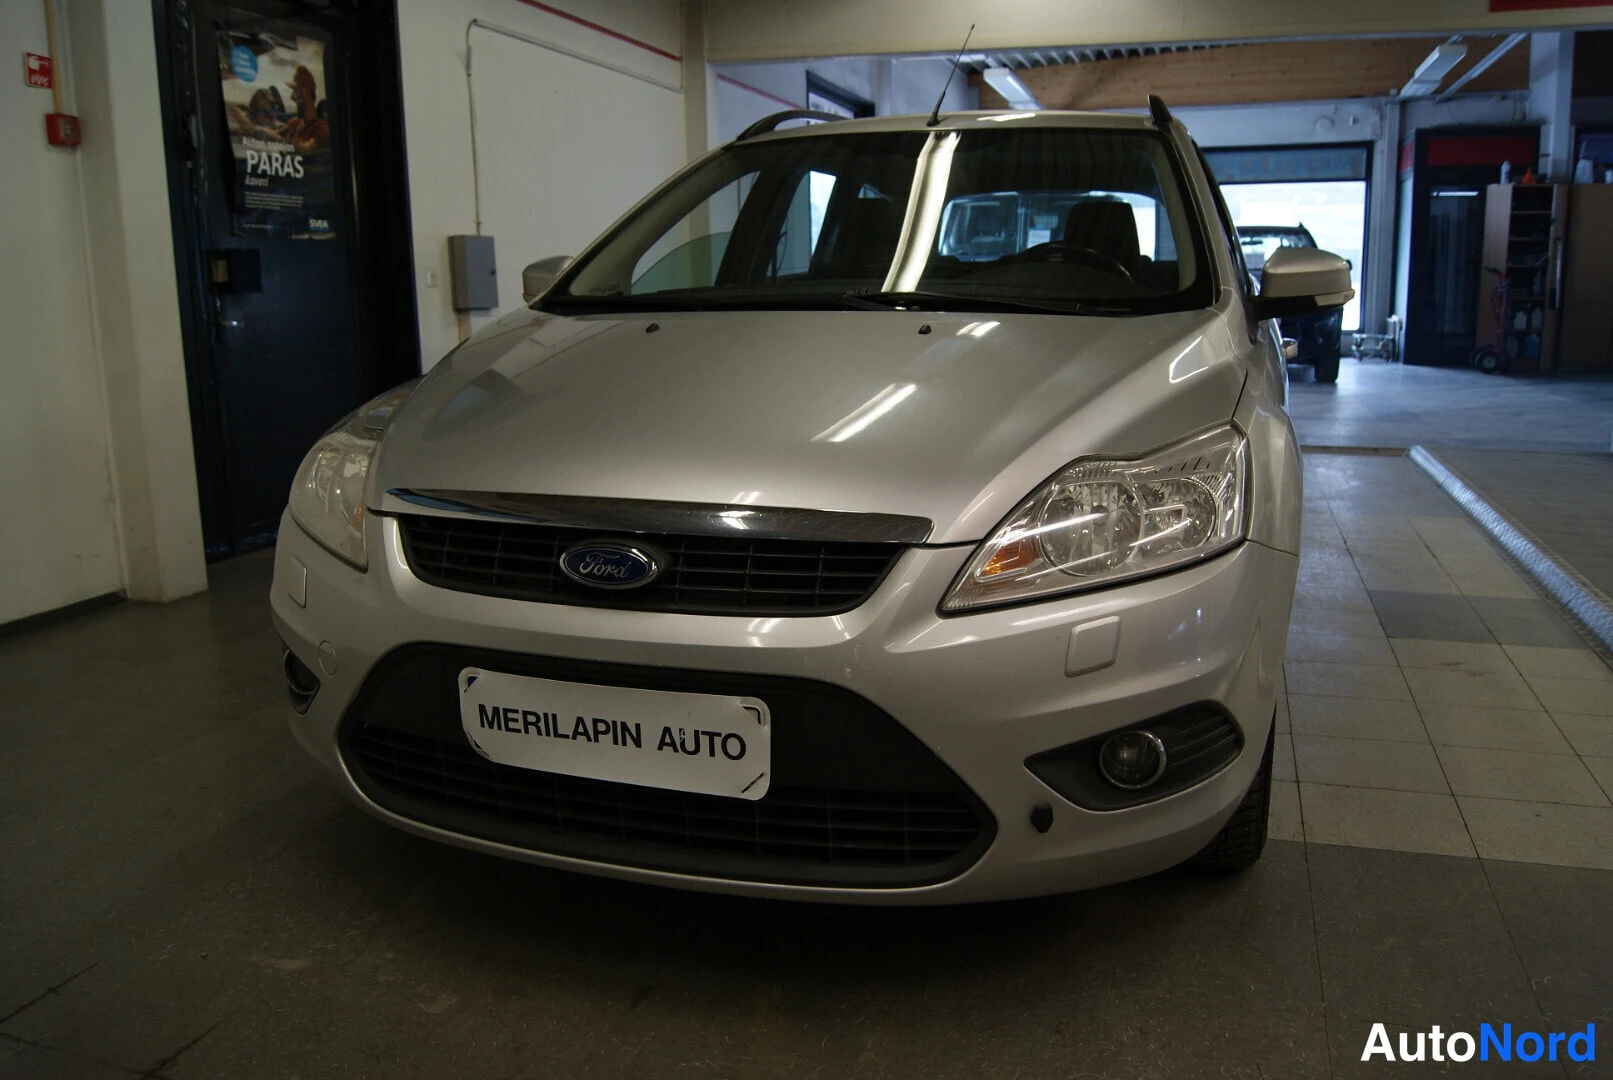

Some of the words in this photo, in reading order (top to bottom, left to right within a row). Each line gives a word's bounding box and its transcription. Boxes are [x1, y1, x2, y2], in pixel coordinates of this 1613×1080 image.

[246, 149, 305, 179] PARAS
[308, 218, 329, 229] SVEA
[579, 551, 632, 578] Ford
[478, 703, 643, 749] MERILAPIN
[657, 726, 748, 761] AUTO
